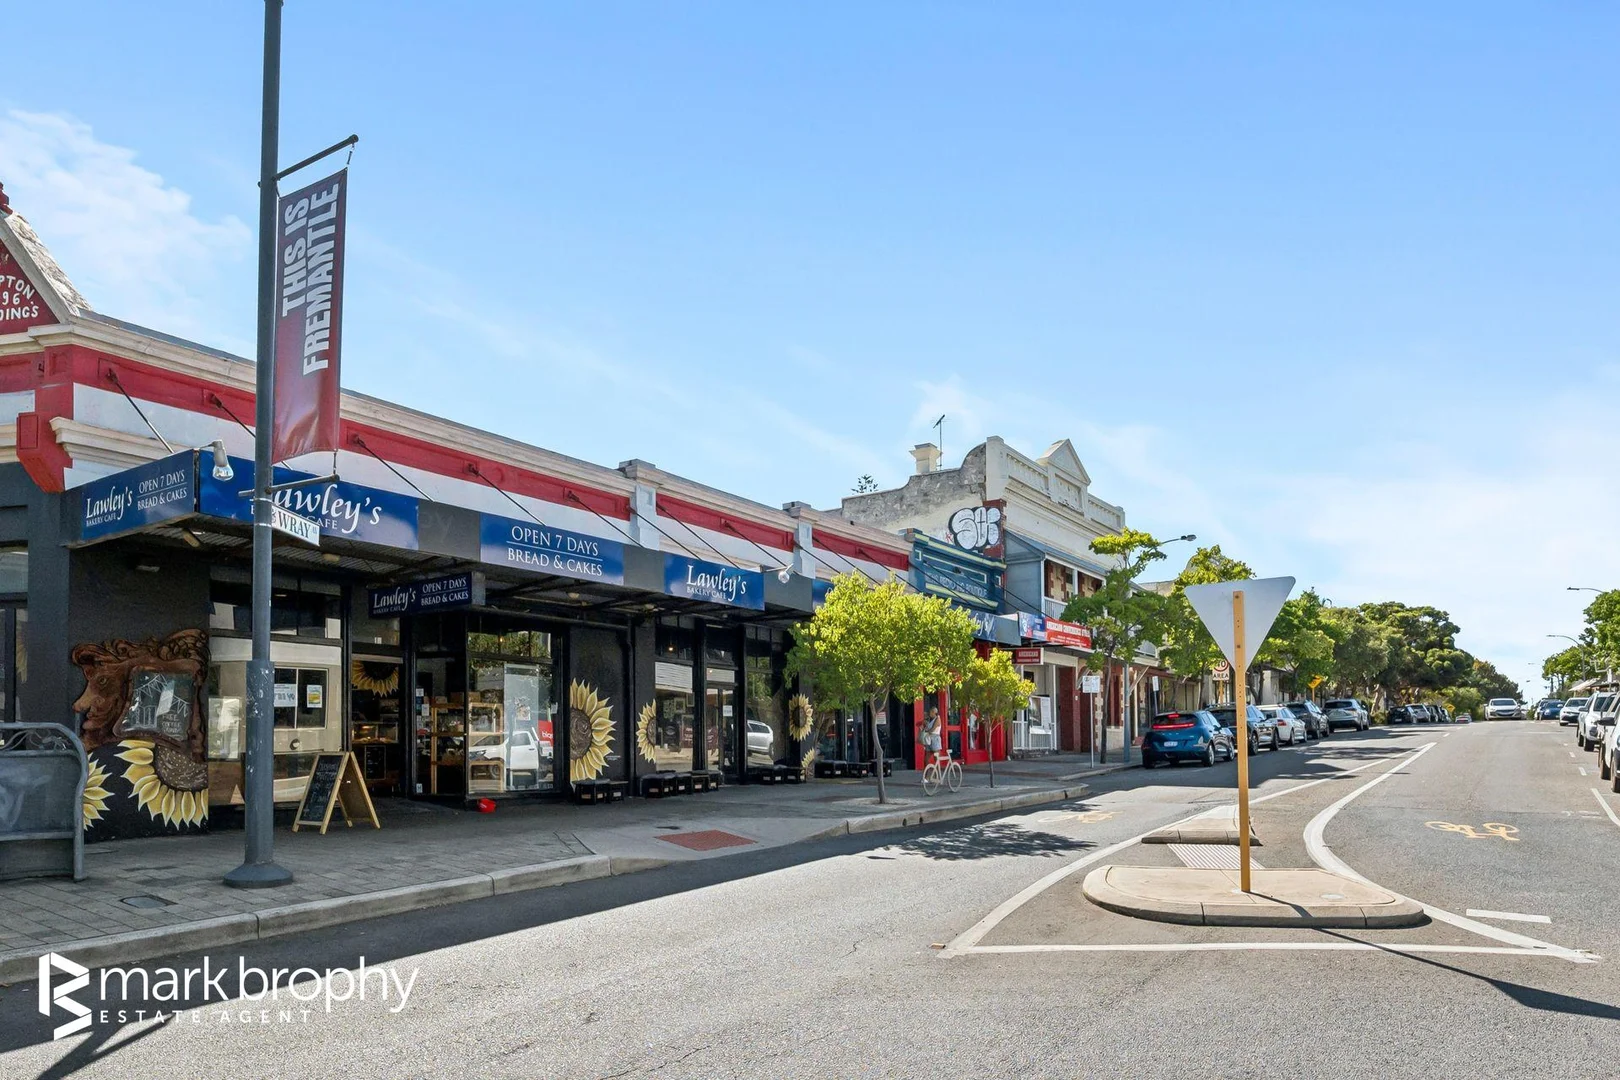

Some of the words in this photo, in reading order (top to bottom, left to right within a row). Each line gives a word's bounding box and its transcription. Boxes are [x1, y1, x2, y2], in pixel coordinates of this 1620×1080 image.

[285, 197, 309, 236] IS
[283, 237, 307, 317] THIS
[303, 183, 339, 376] FREMANTLE
[139, 476, 159, 493] OPEN
[160, 475, 165, 489] 7
[166, 469, 185, 486] DAYS
[86, 486, 132, 520] Lawley's
[137, 495, 158, 511] BREAD
[159, 492, 165, 505] &
[166, 487, 187, 502] CAKES
[272, 483, 382, 534] awley's
[278, 510, 311, 539] WRAY
[512, 526, 550, 547] OPEN
[555, 534, 562, 548] 7
[567, 537, 599, 556] DAYS
[508, 548, 550, 567] BREAD
[553, 554, 564, 570] &
[567, 559, 603, 576] CAKES
[422, 582, 441, 593] OPEN
[443, 581, 448, 590] 7
[449, 577, 467, 589] DAYS
[686, 565, 747, 601] Lawley's
[687, 586, 710, 597] BAKERY
[373, 586, 416, 611] Lawley's
[421, 596, 440, 606] BREAD
[441, 593, 448, 603] &
[449, 591, 469, 601] CAKES
